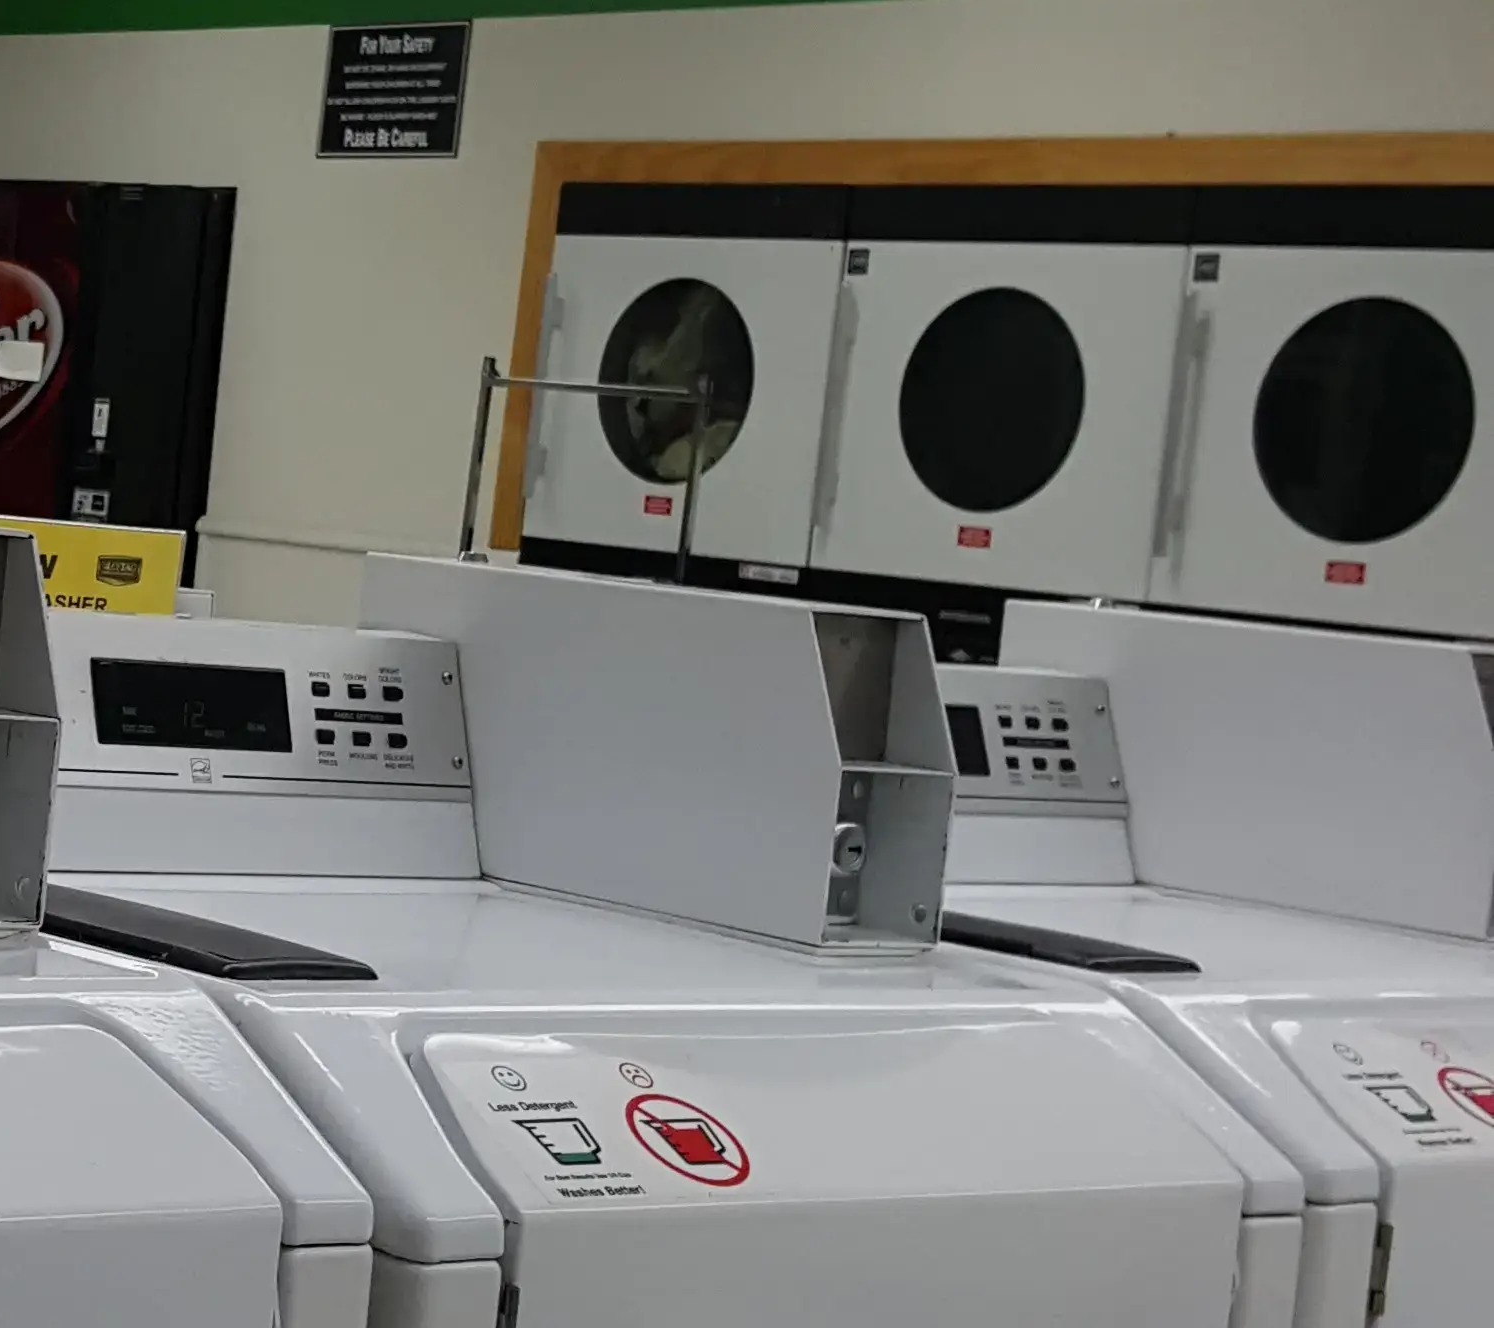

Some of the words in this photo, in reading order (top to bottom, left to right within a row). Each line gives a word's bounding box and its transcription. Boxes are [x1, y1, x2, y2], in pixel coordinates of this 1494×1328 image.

[360, 36, 378, 55] FOR
[379, 35, 402, 54] YOUR
[403, 33, 435, 54] SAFETY
[344, 126, 375, 147] PLEASE
[377, 126, 390, 147] BE
[391, 126, 428, 147] CAREFUL
[488, 1102, 519, 1112] Less
[518, 1100, 578, 1113] Detergent
[557, 1187, 604, 1198] Washes
[605, 1184, 646, 1197] Better!
